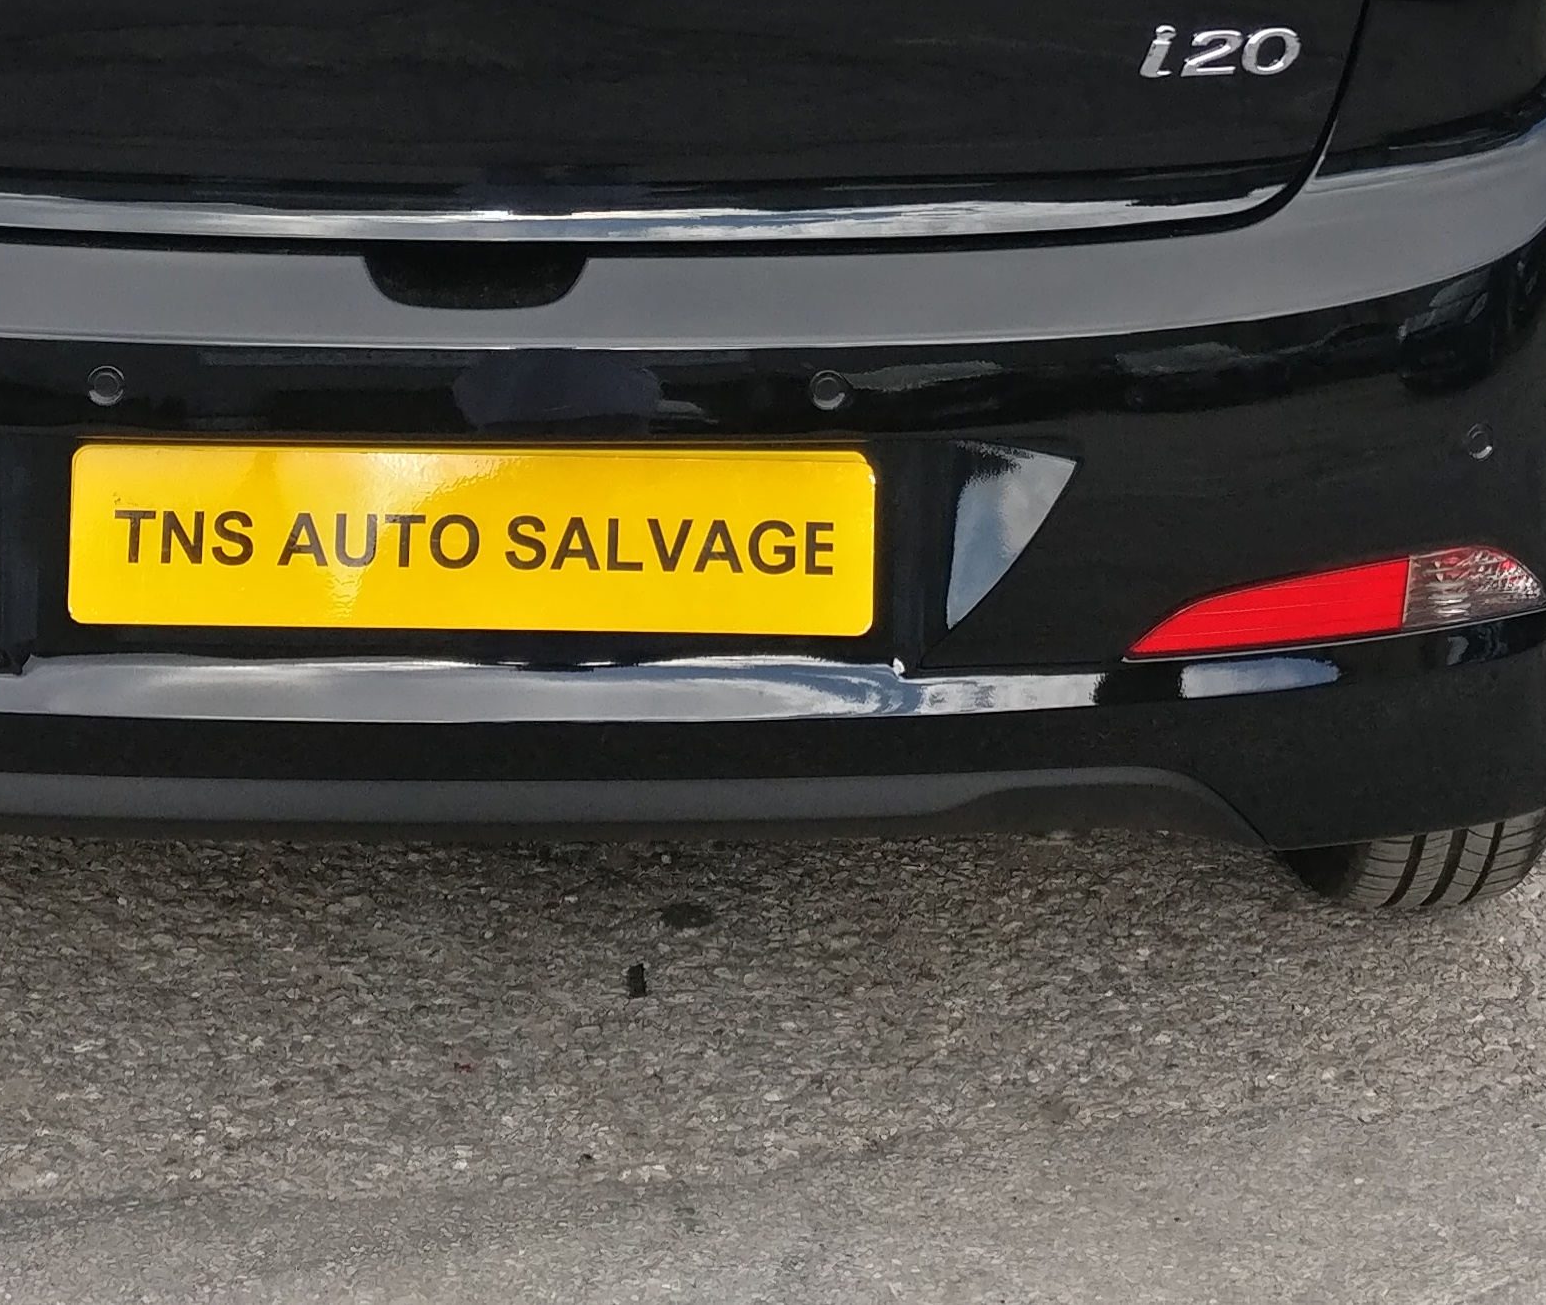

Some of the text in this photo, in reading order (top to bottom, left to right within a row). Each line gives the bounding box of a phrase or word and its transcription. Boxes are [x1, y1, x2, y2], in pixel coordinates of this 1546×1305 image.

[1139, 24, 1302, 79] i20
[113, 509, 835, 576] TNS AUTO SALVAGE
